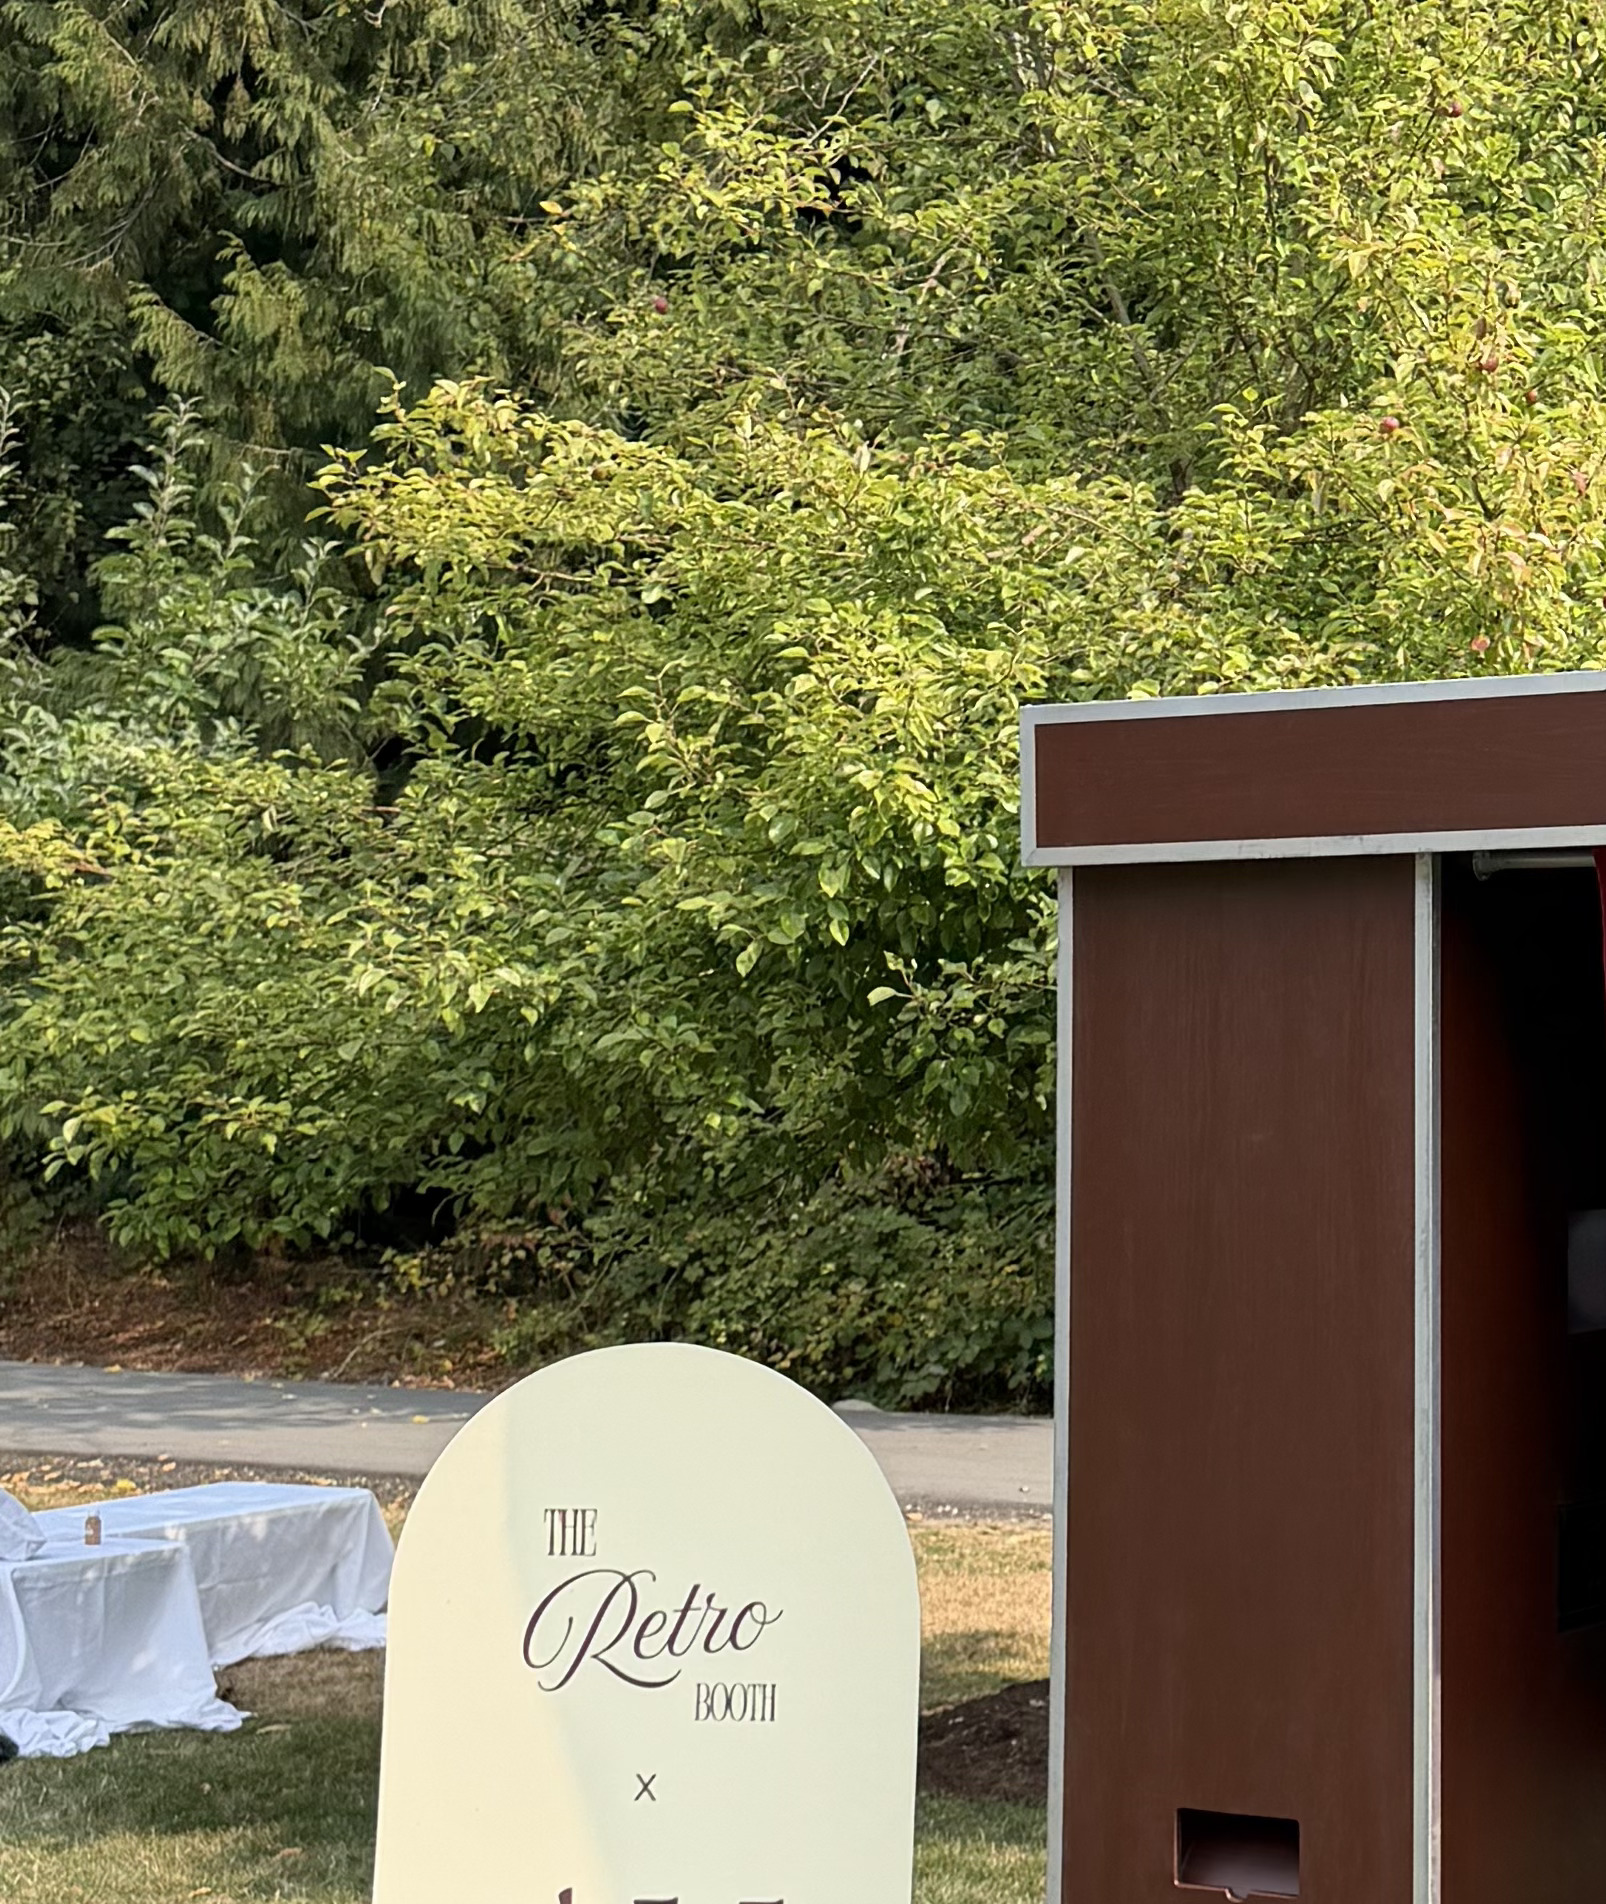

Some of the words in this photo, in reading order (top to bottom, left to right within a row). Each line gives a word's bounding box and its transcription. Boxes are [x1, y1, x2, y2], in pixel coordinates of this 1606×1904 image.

[544, 1508, 597, 1557] THE
[522, 1569, 784, 1692] Retro
[694, 1682, 777, 1723] BOOTH
